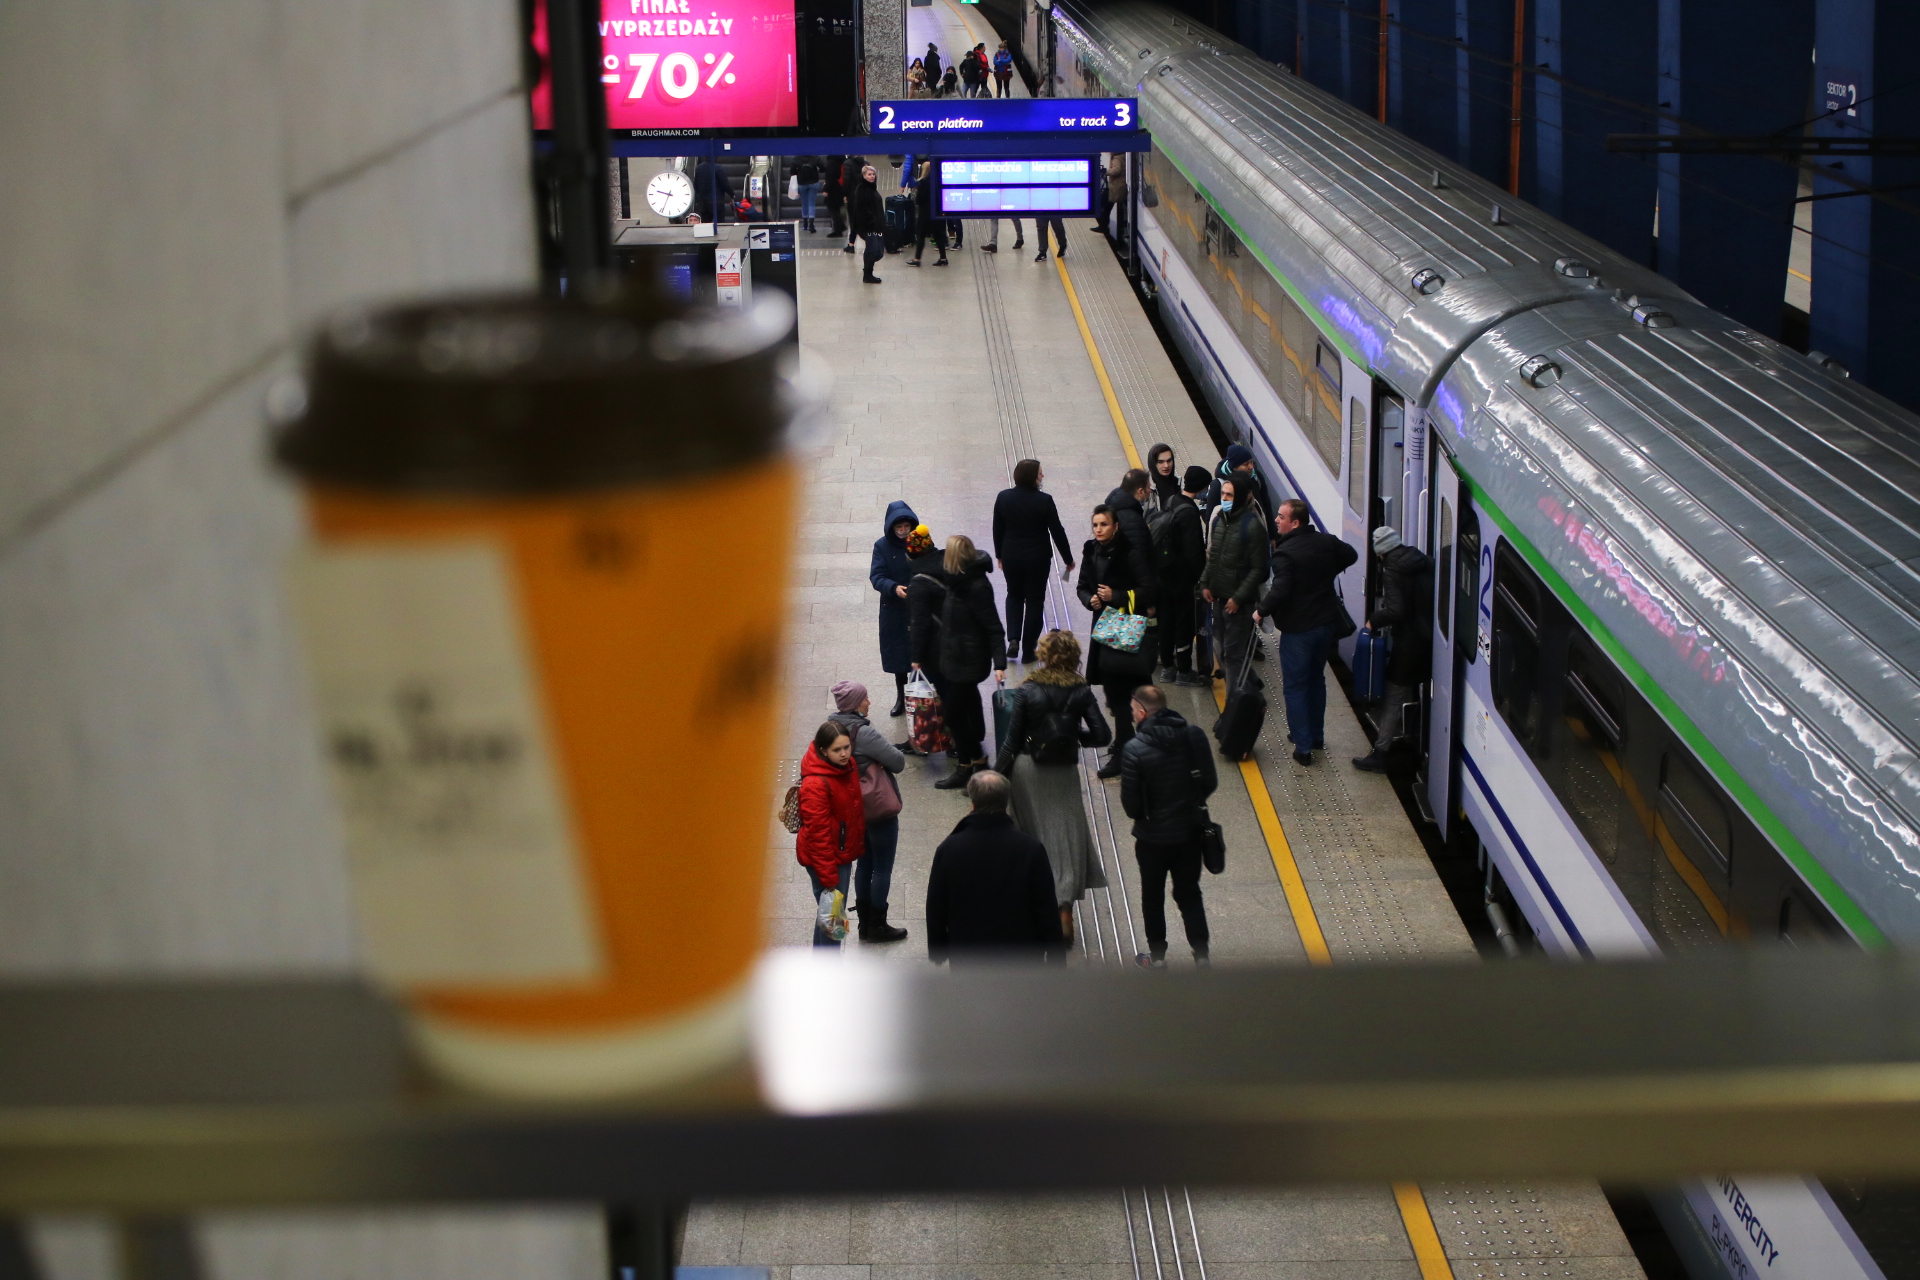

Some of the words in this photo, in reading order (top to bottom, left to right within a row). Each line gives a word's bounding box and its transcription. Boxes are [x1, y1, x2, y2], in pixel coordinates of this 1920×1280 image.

[630, 0, 690, 13] FINAŁ
[1826, 81, 1847, 97] SEKTOR
[1847, 84, 1856, 117] 2
[878, 106, 895, 129] 2
[902, 120, 933, 131] peron
[938, 117, 983, 131] platform
[1059, 117, 1076, 127] tor
[1080, 115, 1107, 127] track
[1114, 103, 1131, 127] 3
[631, 129, 700, 137] BRAUGHMAN.COM
[974, 162, 1022, 173] Wschodnia
[1031, 161, 1075, 172] Warszawa
[1480, 544, 1492, 620] 2
